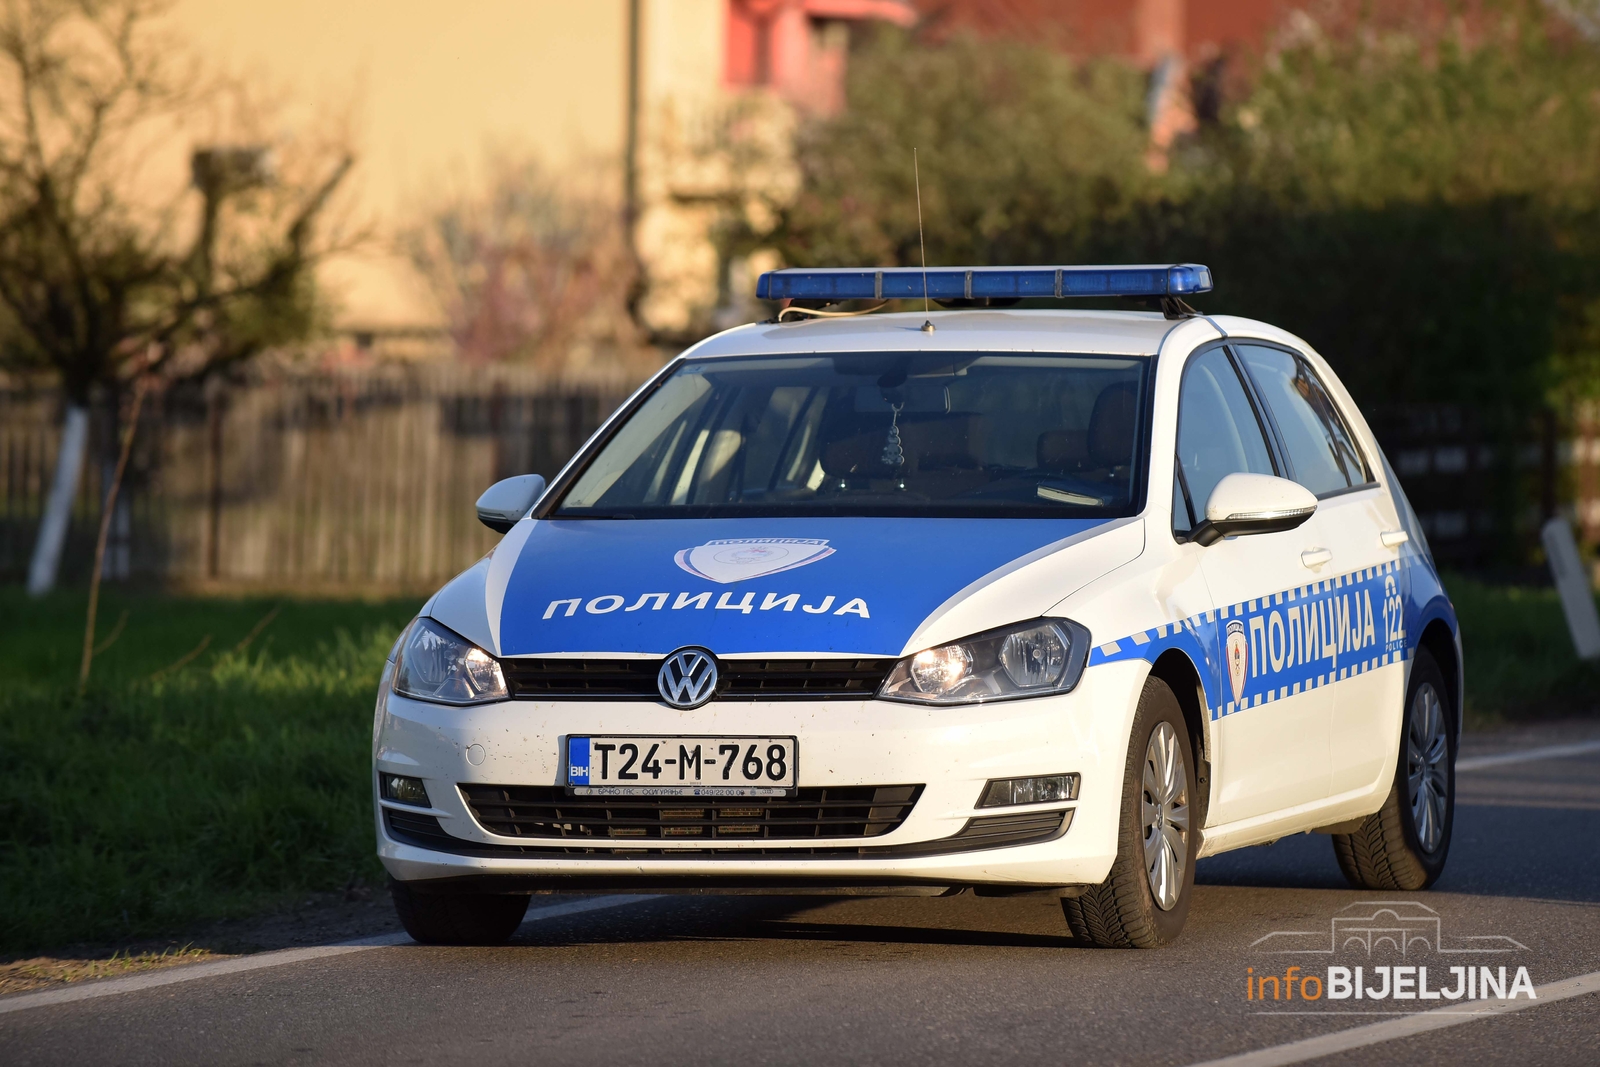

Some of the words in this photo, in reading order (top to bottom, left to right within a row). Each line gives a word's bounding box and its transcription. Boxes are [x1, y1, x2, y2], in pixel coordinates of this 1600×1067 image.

[543, 592, 870, 619] ПОЛИЦИЈА
[1382, 594, 1406, 643] 122
[1249, 590, 1376, 678] ПОЛИЦИЈА
[1385, 640, 1407, 652] POLICE
[570, 766, 588, 776] BIH
[594, 743, 787, 781] T24-M-768
